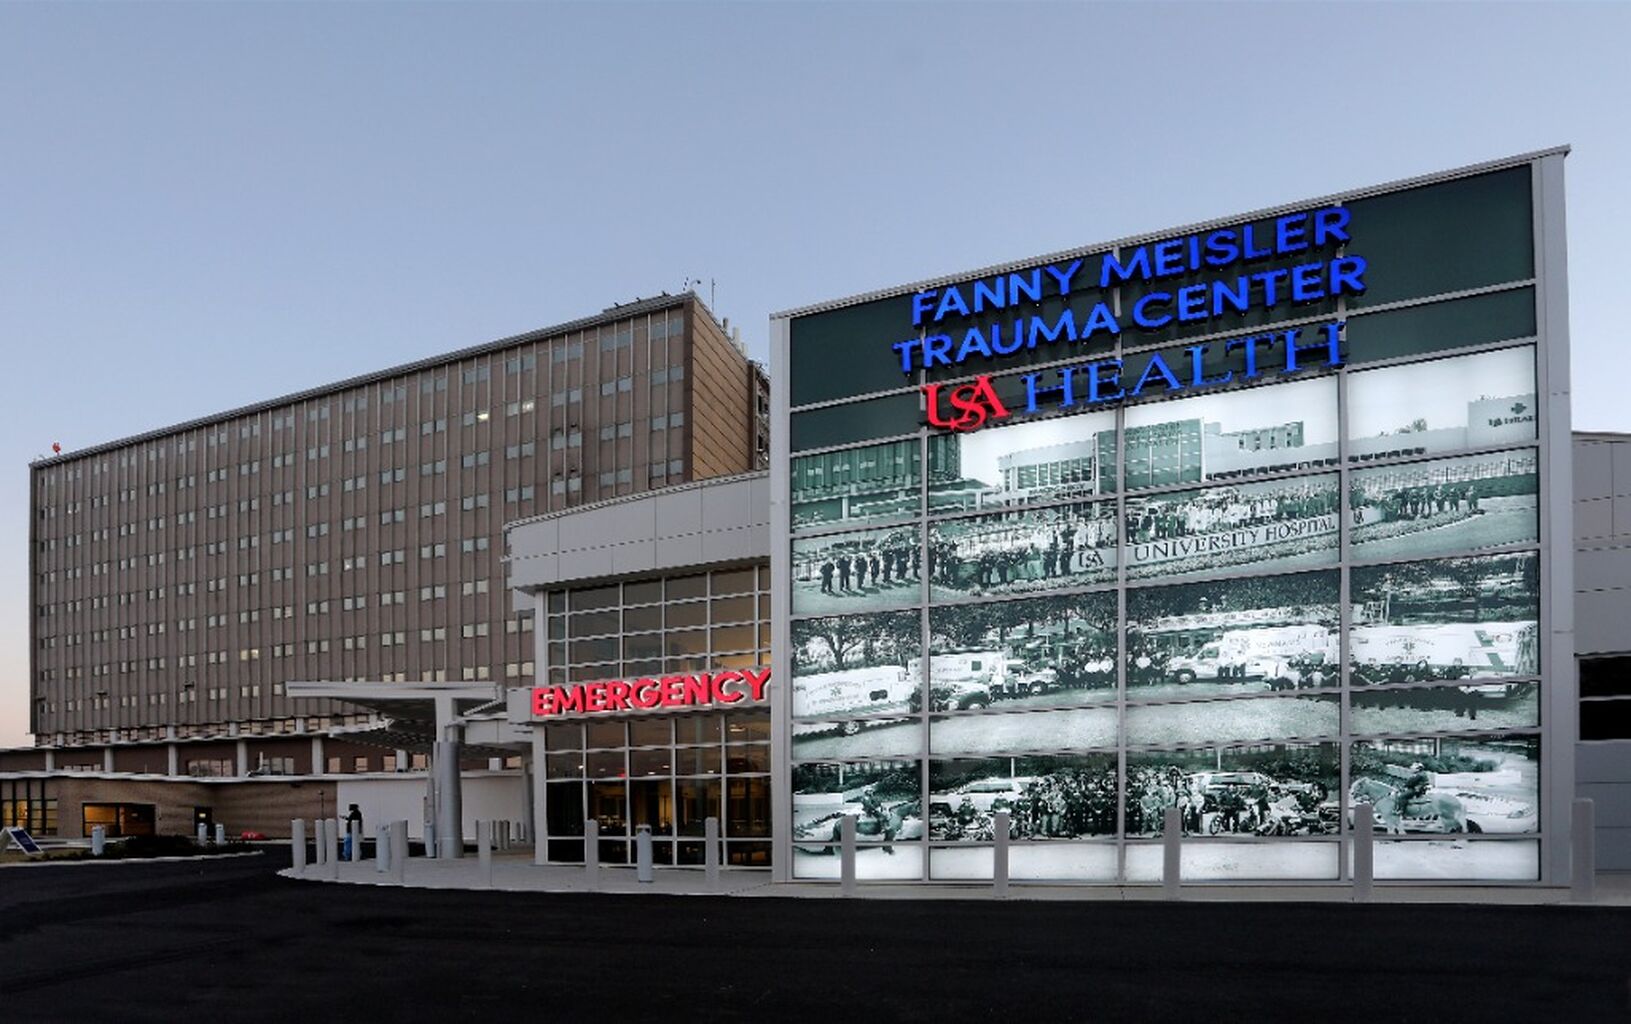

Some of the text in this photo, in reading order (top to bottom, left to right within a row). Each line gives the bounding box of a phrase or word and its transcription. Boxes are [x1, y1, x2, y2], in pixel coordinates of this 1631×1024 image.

[891, 255, 1369, 374] TRAUMA CENTER
[910, 206, 1353, 327] FANNY MEISLER
[922, 320, 1347, 431] USA HEALTH
[1134, 528, 1260, 561] UNIVERSITY
[1265, 516, 1336, 541] HOSPITAL
[531, 667, 772, 717] EMERGENCY
